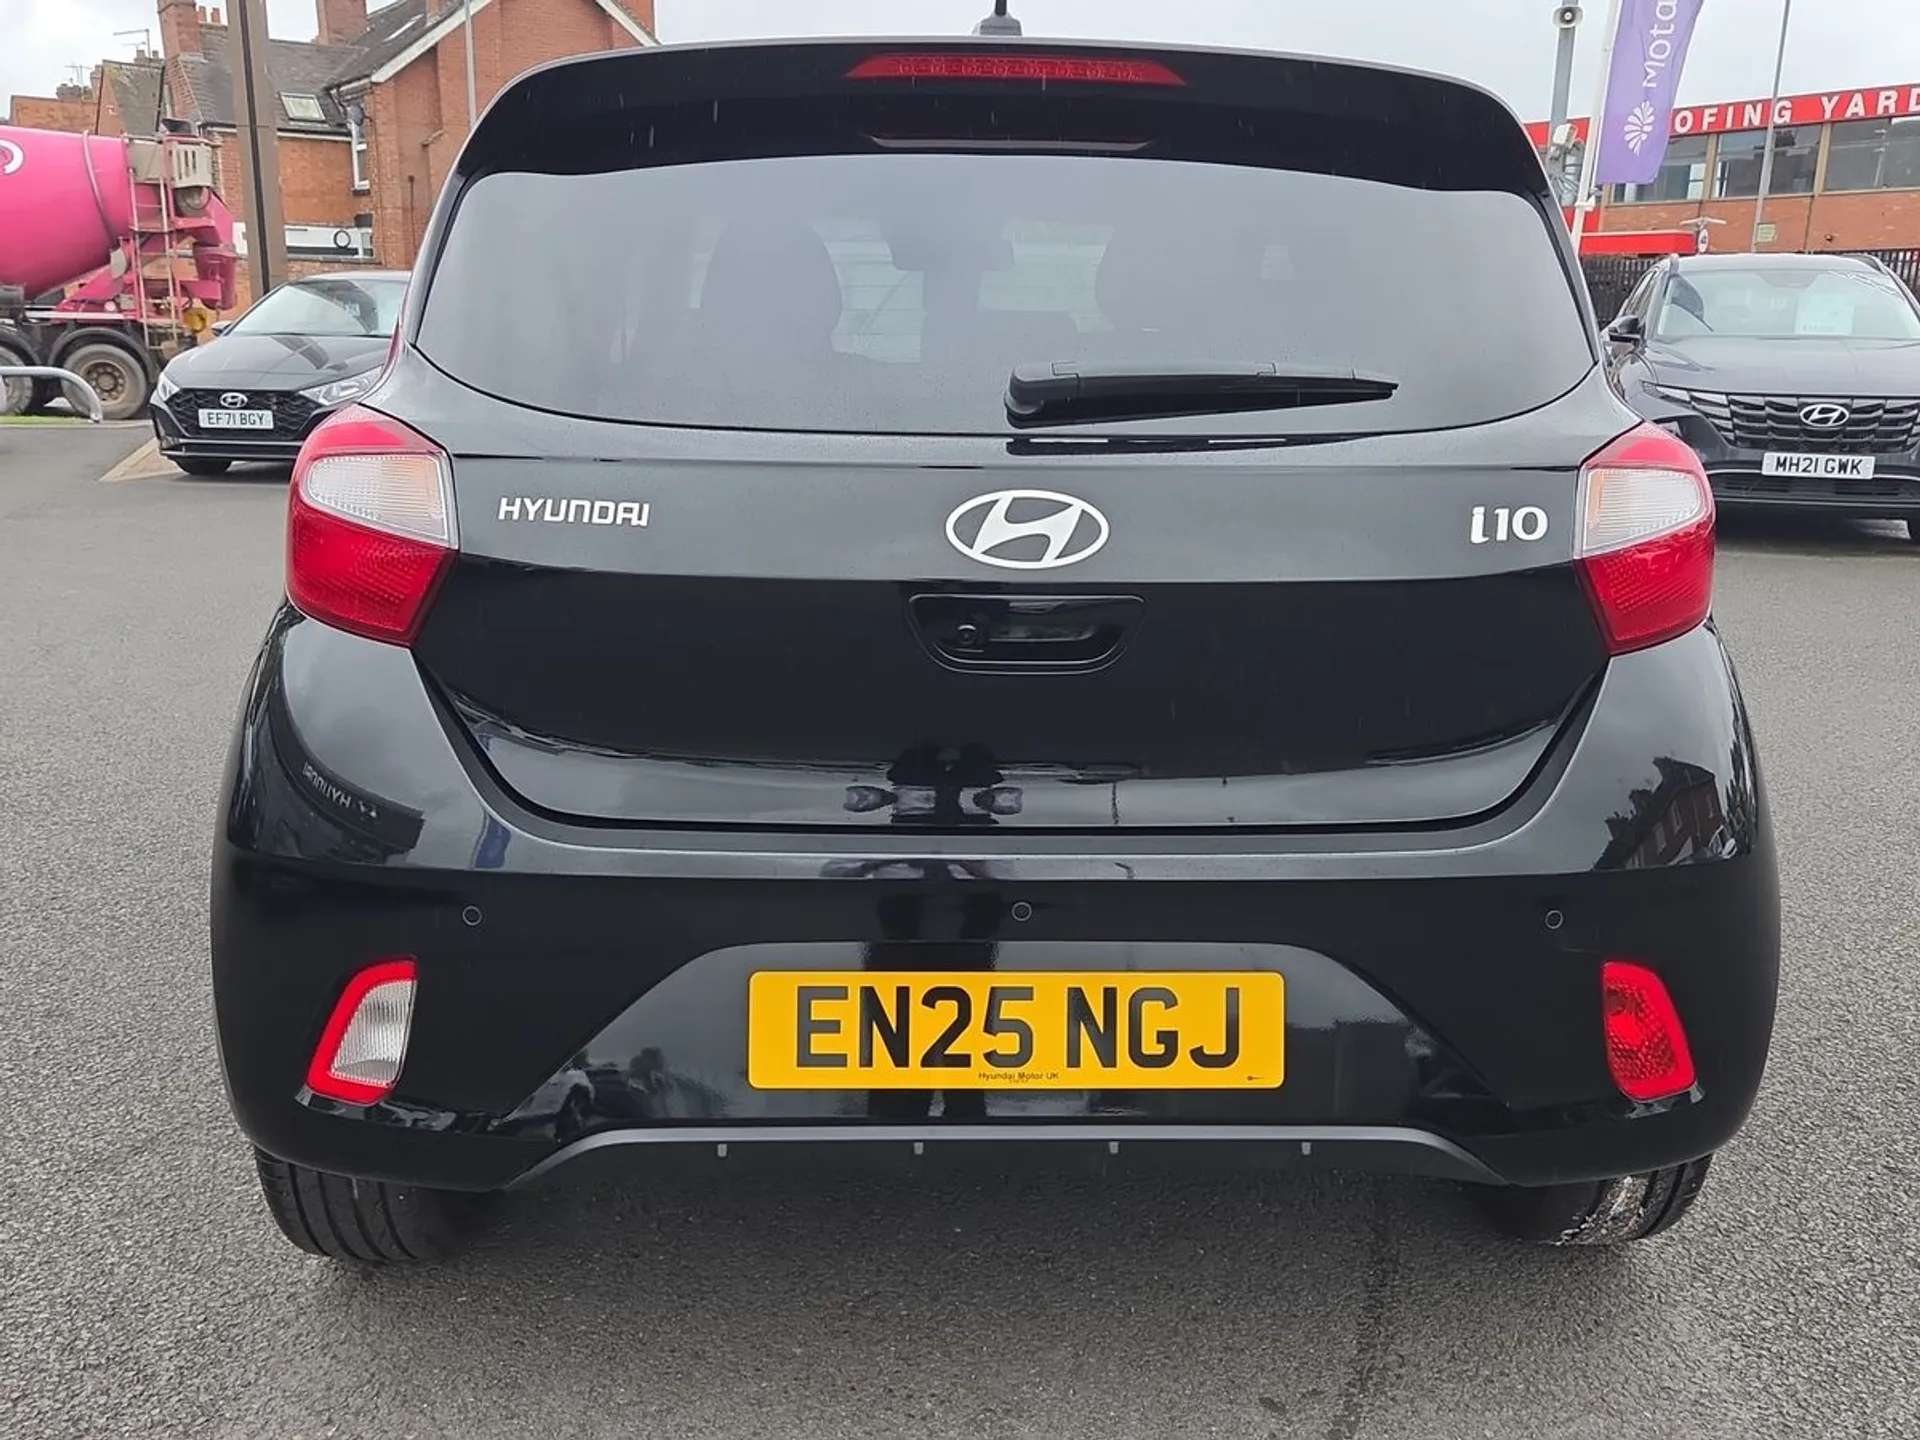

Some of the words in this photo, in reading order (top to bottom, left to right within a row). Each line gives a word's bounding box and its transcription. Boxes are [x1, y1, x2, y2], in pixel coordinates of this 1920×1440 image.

[207, 411, 237, 425] EF71
[240, 412, 265, 426] BGY
[1775, 456, 1819, 474] MH21
[1824, 457, 1863, 475] GWK
[498, 497, 650, 527] HYUNDAI
[1470, 506, 1549, 544] i10
[796, 985, 1035, 1069] EN25
[1065, 985, 1241, 1069] NGJ
[978, 1072, 1016, 1081] Hyundai
[1018, 1072, 1044, 1080] Motor
[1046, 1072, 1060, 1080] UK
